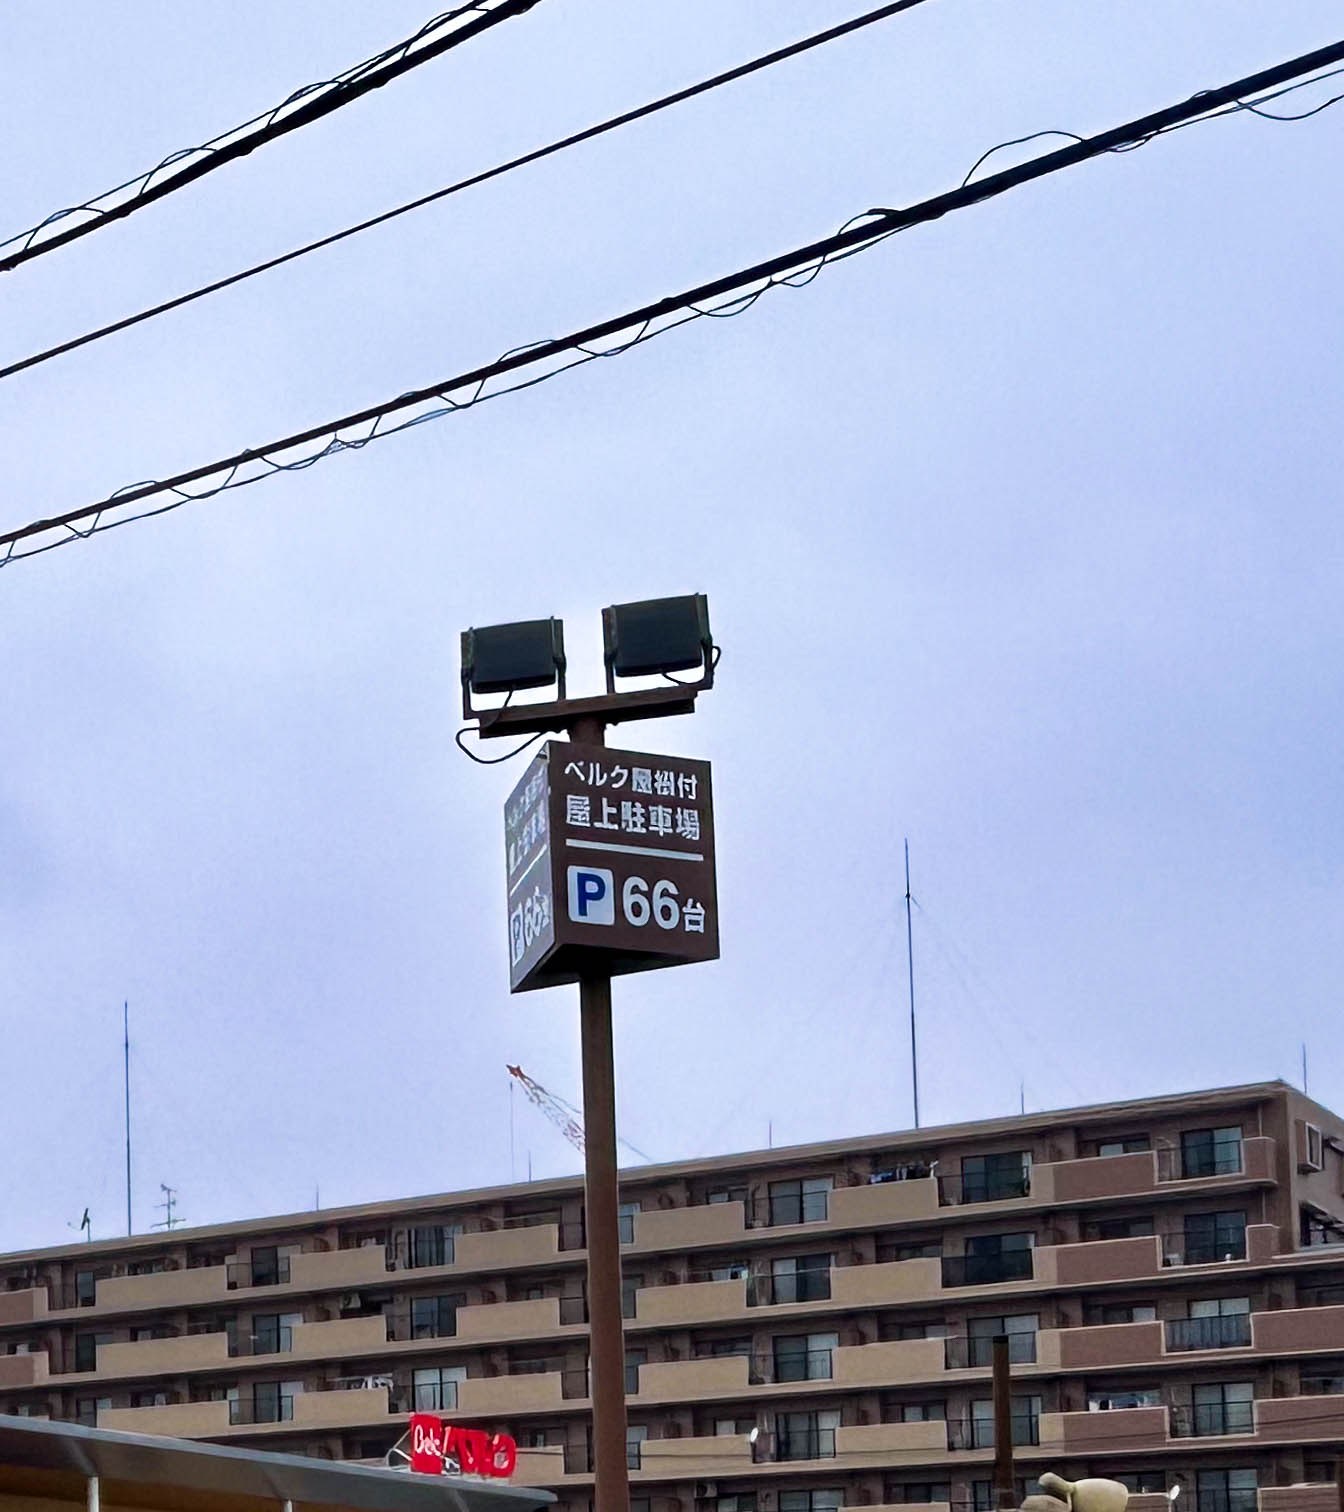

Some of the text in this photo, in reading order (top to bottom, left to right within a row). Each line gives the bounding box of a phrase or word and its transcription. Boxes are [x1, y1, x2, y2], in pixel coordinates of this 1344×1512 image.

[564, 760, 698, 800] ベルク屋根付
[566, 794, 700, 841] 屋上駐車場
[577, 872, 706, 934] P 66台
